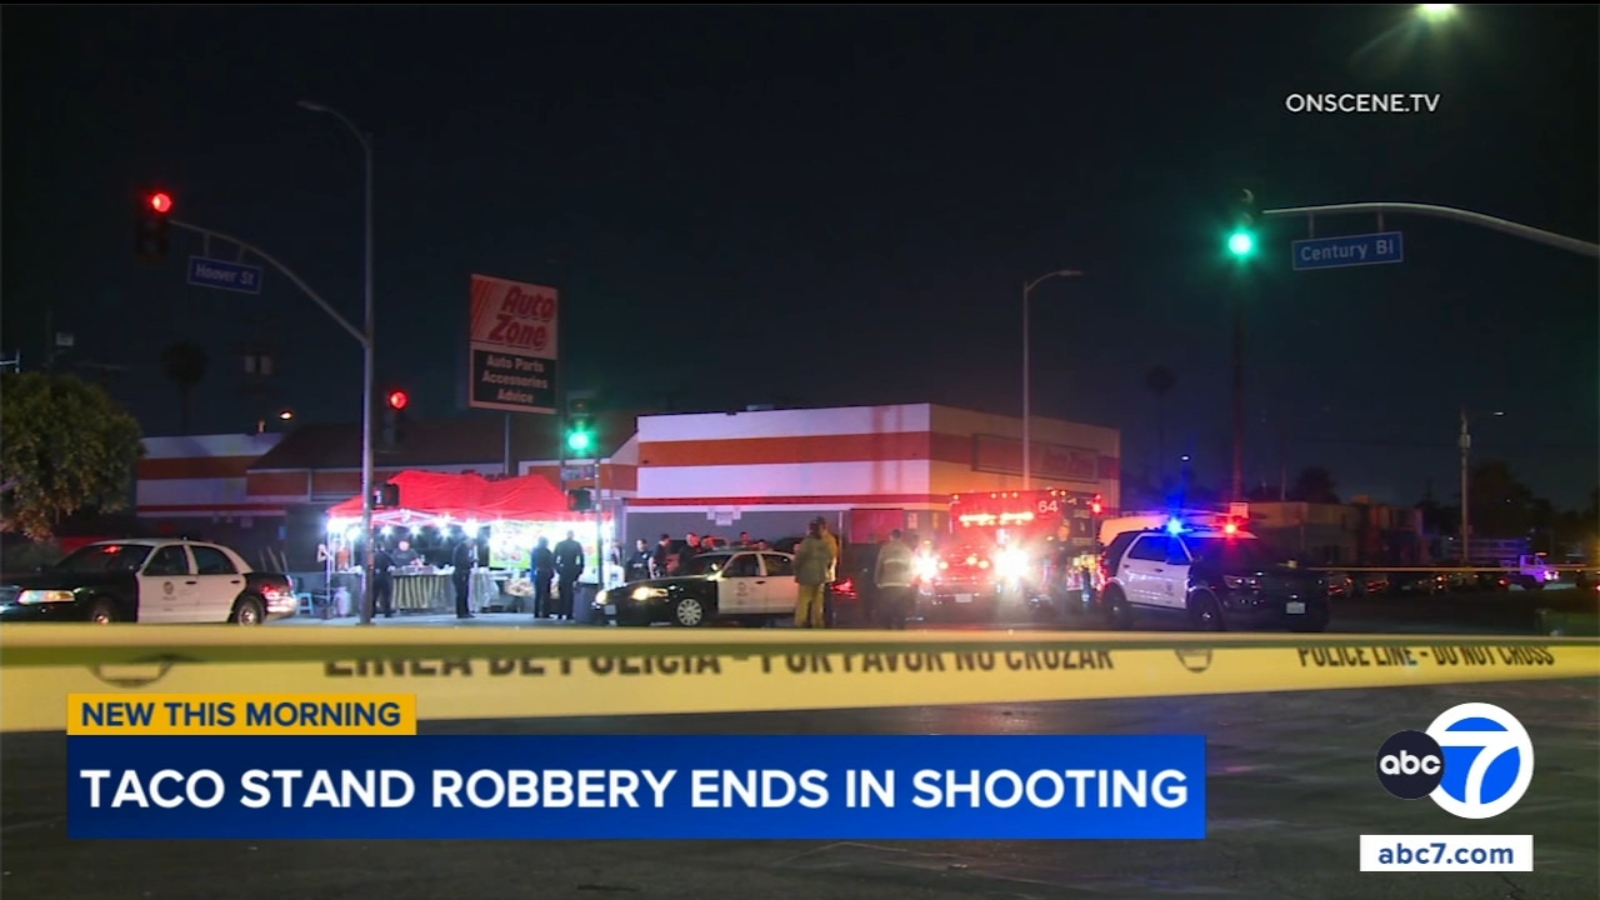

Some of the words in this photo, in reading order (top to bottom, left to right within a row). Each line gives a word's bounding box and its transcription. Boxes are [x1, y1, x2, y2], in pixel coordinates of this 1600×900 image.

[1300, 243, 1368, 260] Century
[1376, 239, 1394, 255] Bl
[195, 263, 238, 282] Hoover
[240, 270, 255, 285] St
[501, 285, 555, 321] Auto
[488, 313, 547, 349] Zone
[486, 354, 513, 369] Auto
[515, 358, 545, 373] Parts
[482, 370, 548, 389] Accessories
[497, 389, 534, 403] Advice
[1038, 500, 1058, 514] 64
[1298, 647, 1370, 668] POLICE
[1373, 647, 1418, 667] LINE
